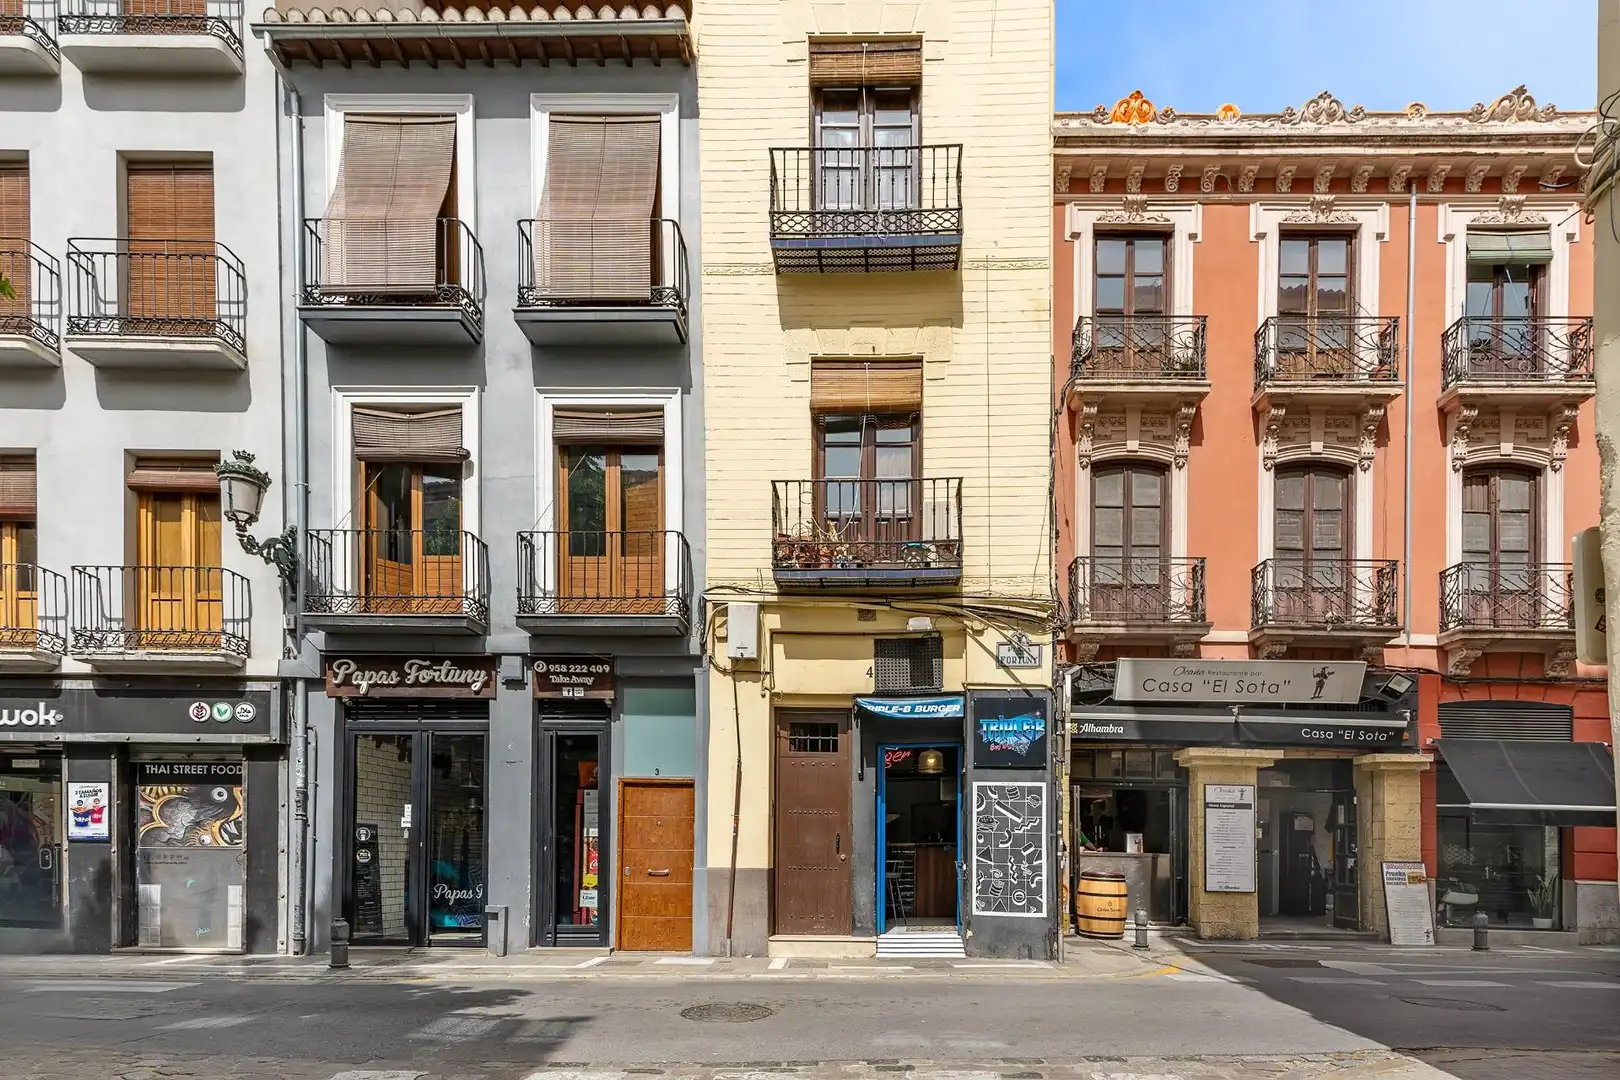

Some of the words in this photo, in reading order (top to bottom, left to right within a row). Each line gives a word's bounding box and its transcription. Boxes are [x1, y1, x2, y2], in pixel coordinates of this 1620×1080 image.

[1001, 656, 1038, 664] FORTUNY
[548, 664, 567, 673] 958
[569, 664, 588, 673] 222
[590, 664, 610, 673] 409
[866, 666, 873, 678] 4
[1173, 665, 1204, 676] Ocaña
[333, 659, 401, 694] Papas
[404, 659, 488, 691] Fortuny
[549, 674, 569, 684] Take
[570, 675, 595, 685] Away
[1143, 678, 1193, 693] Casa
[915, 704, 960, 713] BURGER
[1080, 723, 1123, 734] Alhambra
[1301, 728, 1333, 739] Casa
[145, 764, 170, 774] THAI
[173, 765, 208, 775] STREET
[211, 765, 243, 775] FOOD
[655, 767, 660, 776] 3
[434, 884, 473, 905] Papas
